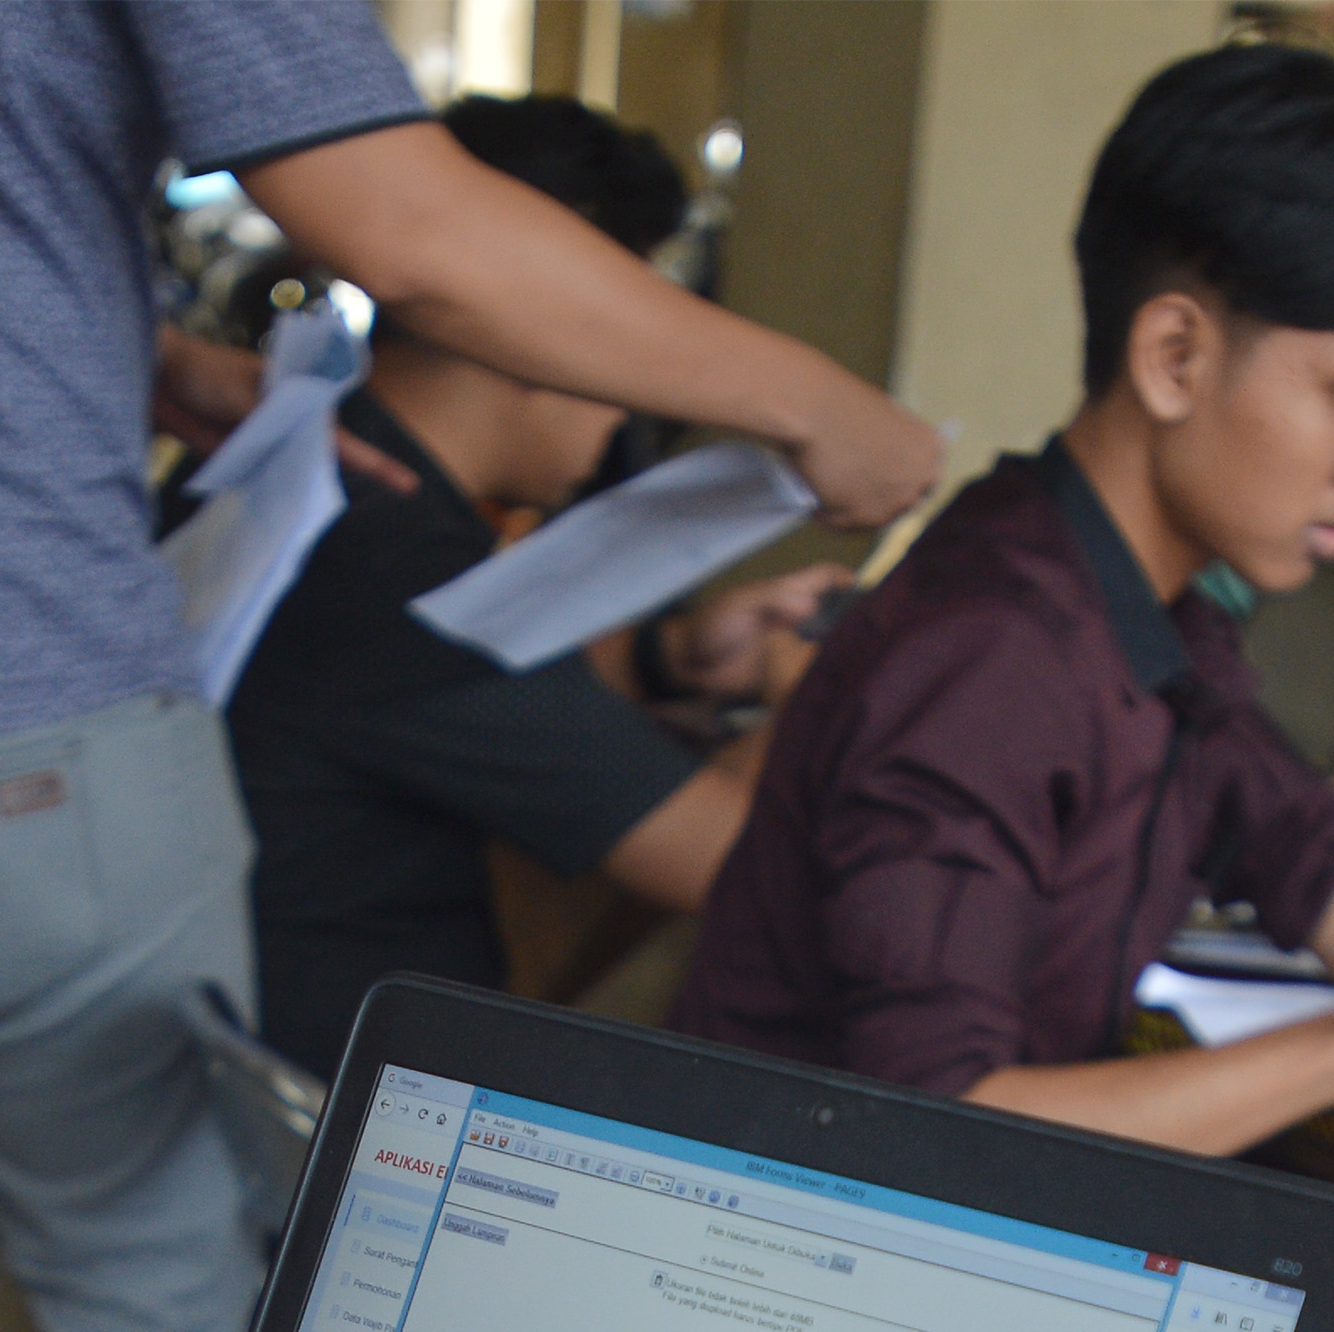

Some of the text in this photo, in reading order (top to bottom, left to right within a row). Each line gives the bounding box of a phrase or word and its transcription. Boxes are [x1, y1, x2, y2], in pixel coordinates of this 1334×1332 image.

[523, 1125, 540, 1138] Help
[374, 1149, 433, 1177] APLIKASI
[1273, 1257, 1303, 1277] 820
